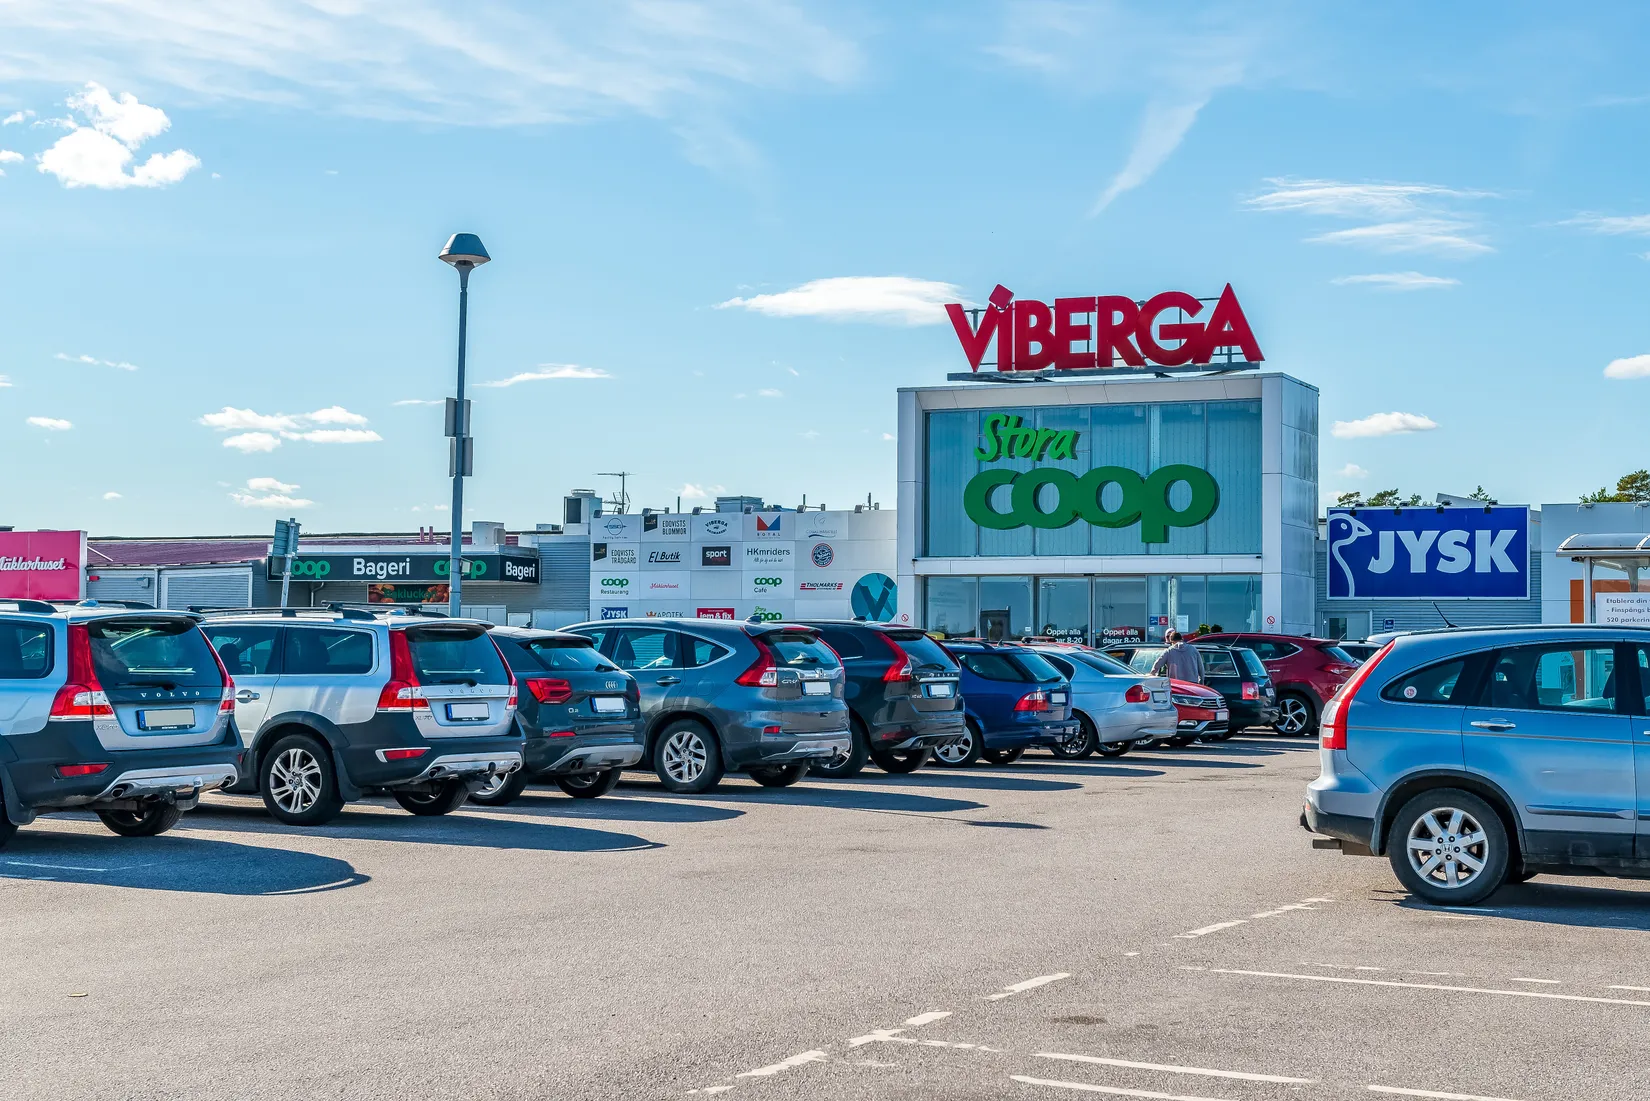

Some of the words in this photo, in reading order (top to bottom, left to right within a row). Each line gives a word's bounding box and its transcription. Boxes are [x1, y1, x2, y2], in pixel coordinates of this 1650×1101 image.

[944, 282, 1266, 373] VIBERGA
[974, 412, 1080, 463] Stora
[963, 464, 1220, 543] coop
[705, 550, 728, 559] sport
[1367, 529, 1520, 574] JYSK
[291, 560, 331, 579] oop
[353, 557, 411, 579] Bageri
[505, 561, 536, 582] Bageri
[600, 578, 629, 588] coop
[754, 577, 783, 587] coop
[606, 610, 627, 618] JYSK
[1046, 627, 1068, 636] Öppet
[1103, 627, 1125, 636] Öppet
[1126, 628, 1139, 636] alla
[140, 690, 200, 698] VOLVO
